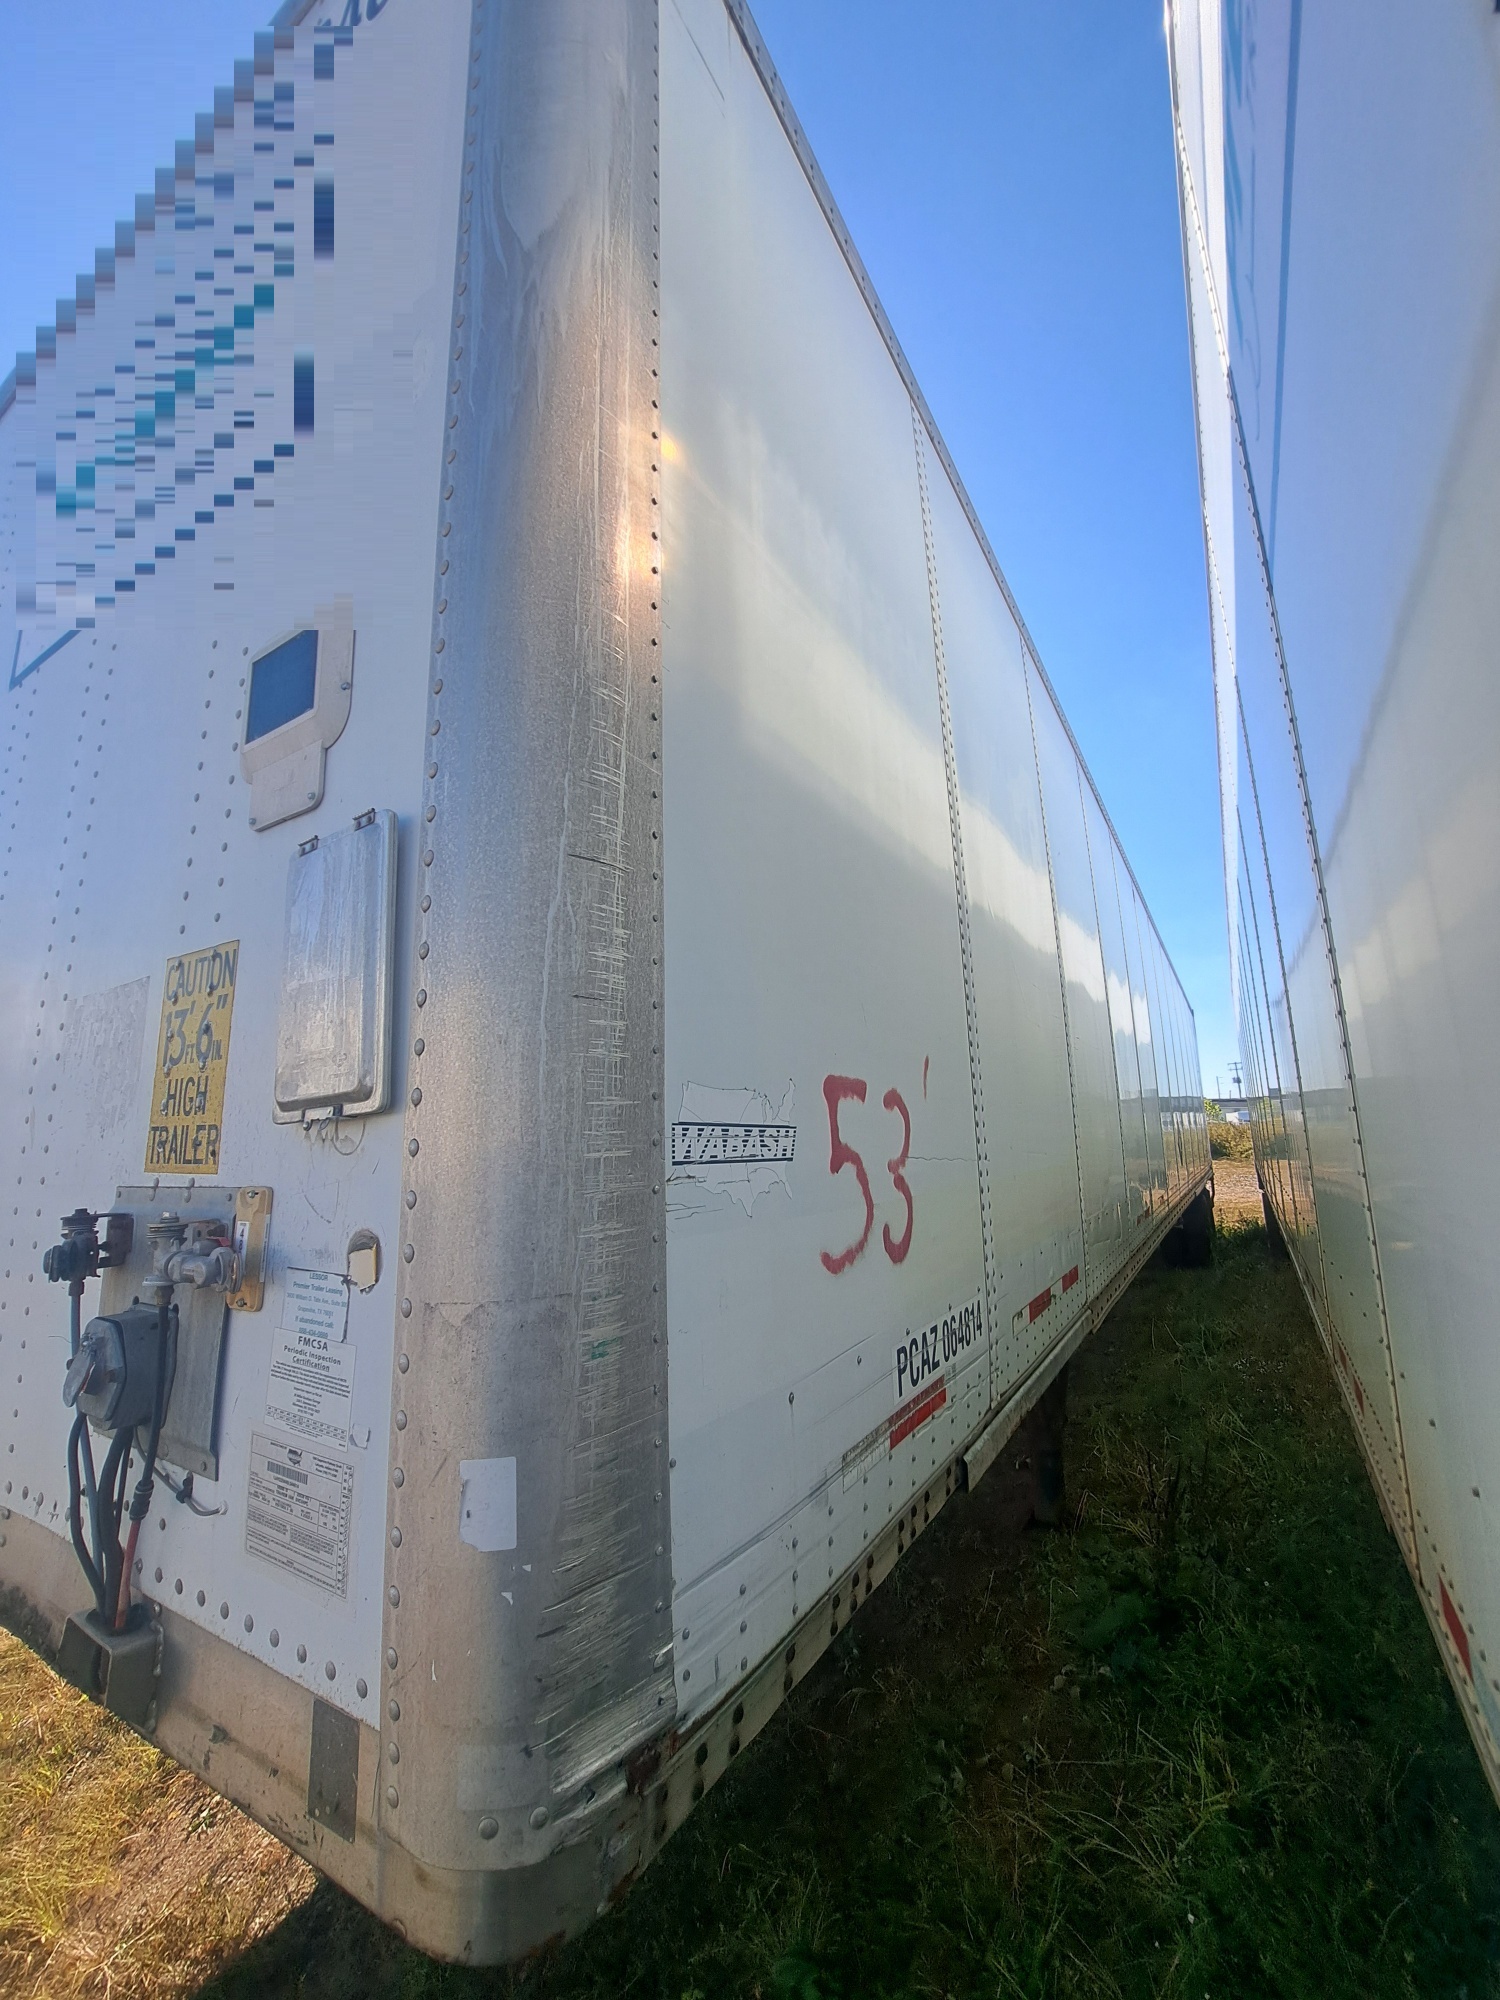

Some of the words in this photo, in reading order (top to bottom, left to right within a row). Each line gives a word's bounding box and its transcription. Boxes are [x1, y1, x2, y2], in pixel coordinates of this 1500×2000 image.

[165, 948, 237, 1001] CAUTION
[164, 1076, 209, 1117] HIGH
[149, 1124, 220, 1165] TRAILER
[311, 1284, 326, 1292] Trailer
[326, 1286, 343, 1297] Leasing
[284, 1345, 308, 1358] Periodic
[309, 1351, 341, 1366] Inspection
[298, 1335, 328, 1352] FMCSA
[896, 1324, 941, 1398] PCAZ
[942, 1299, 983, 1363] 064814
[292, 1355, 330, 1373] Certification
